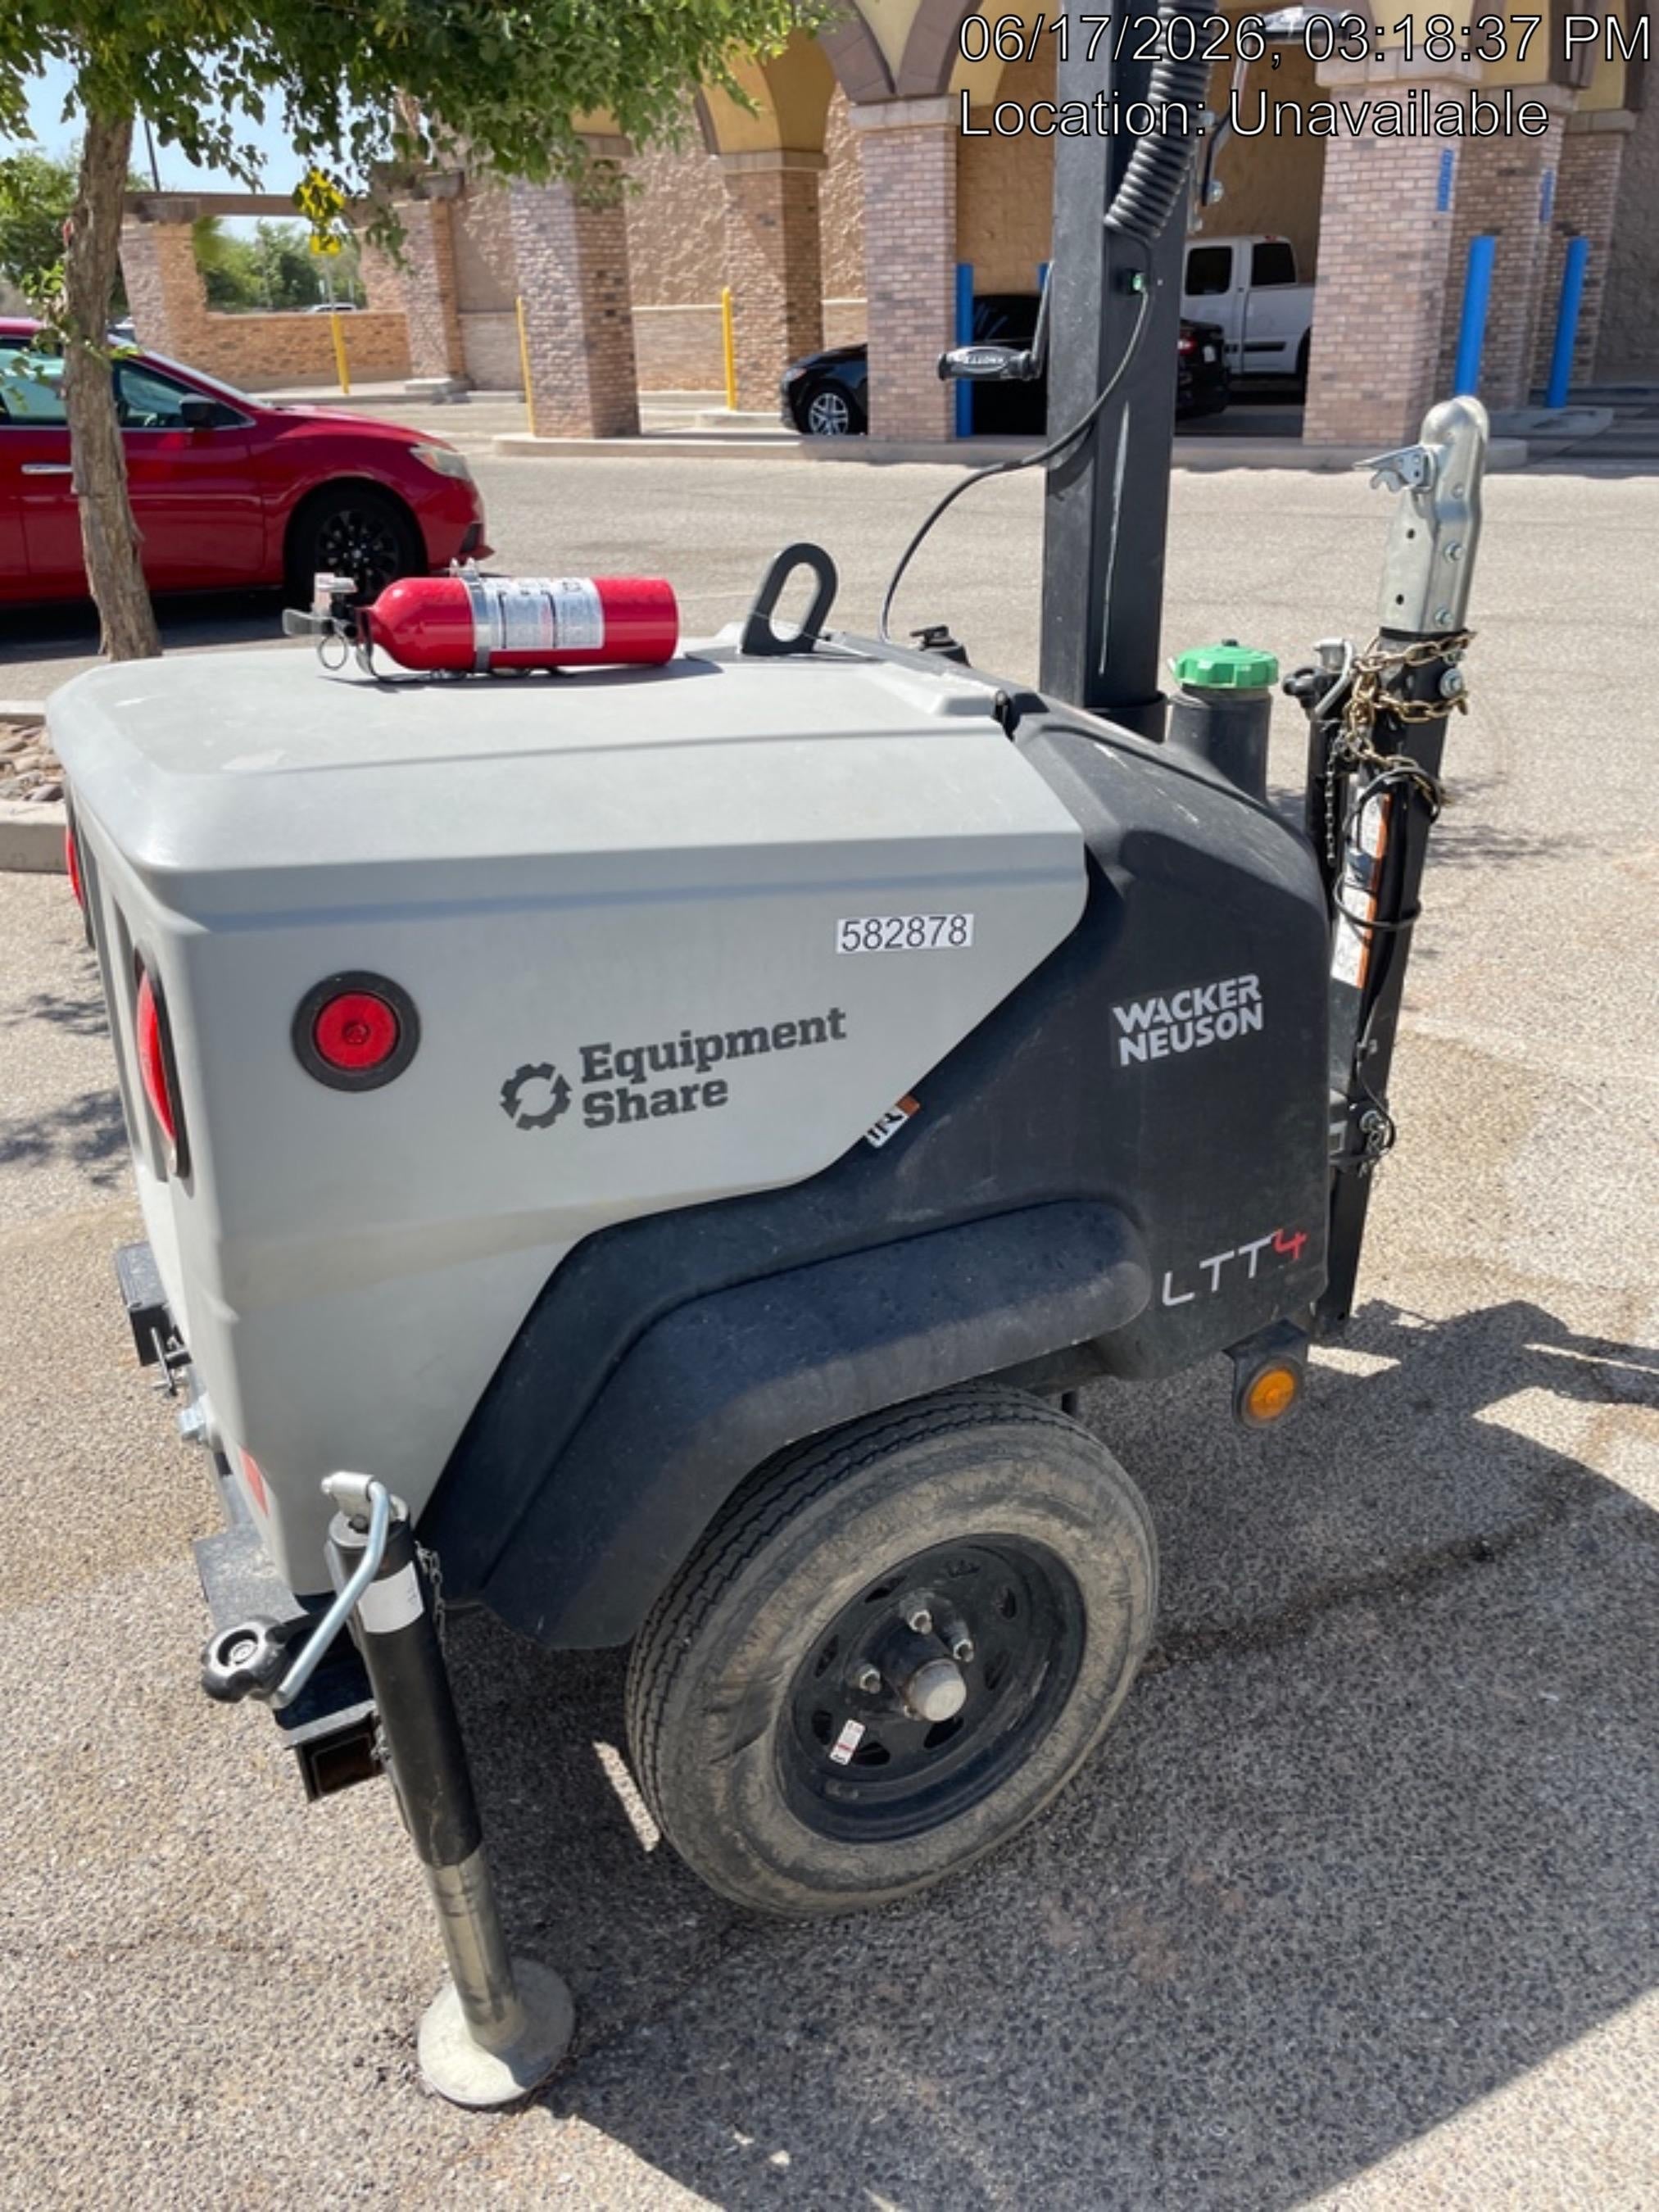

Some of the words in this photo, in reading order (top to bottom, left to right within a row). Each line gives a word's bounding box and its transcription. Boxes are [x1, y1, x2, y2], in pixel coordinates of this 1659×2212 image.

[842, 914, 967, 951] 582878
[1112, 973, 1262, 1034] WACKER
[1119, 1002, 1263, 1066] NEUSON
[579, 1007, 846, 1084] Equipment
[582, 1078, 728, 1128] Share
